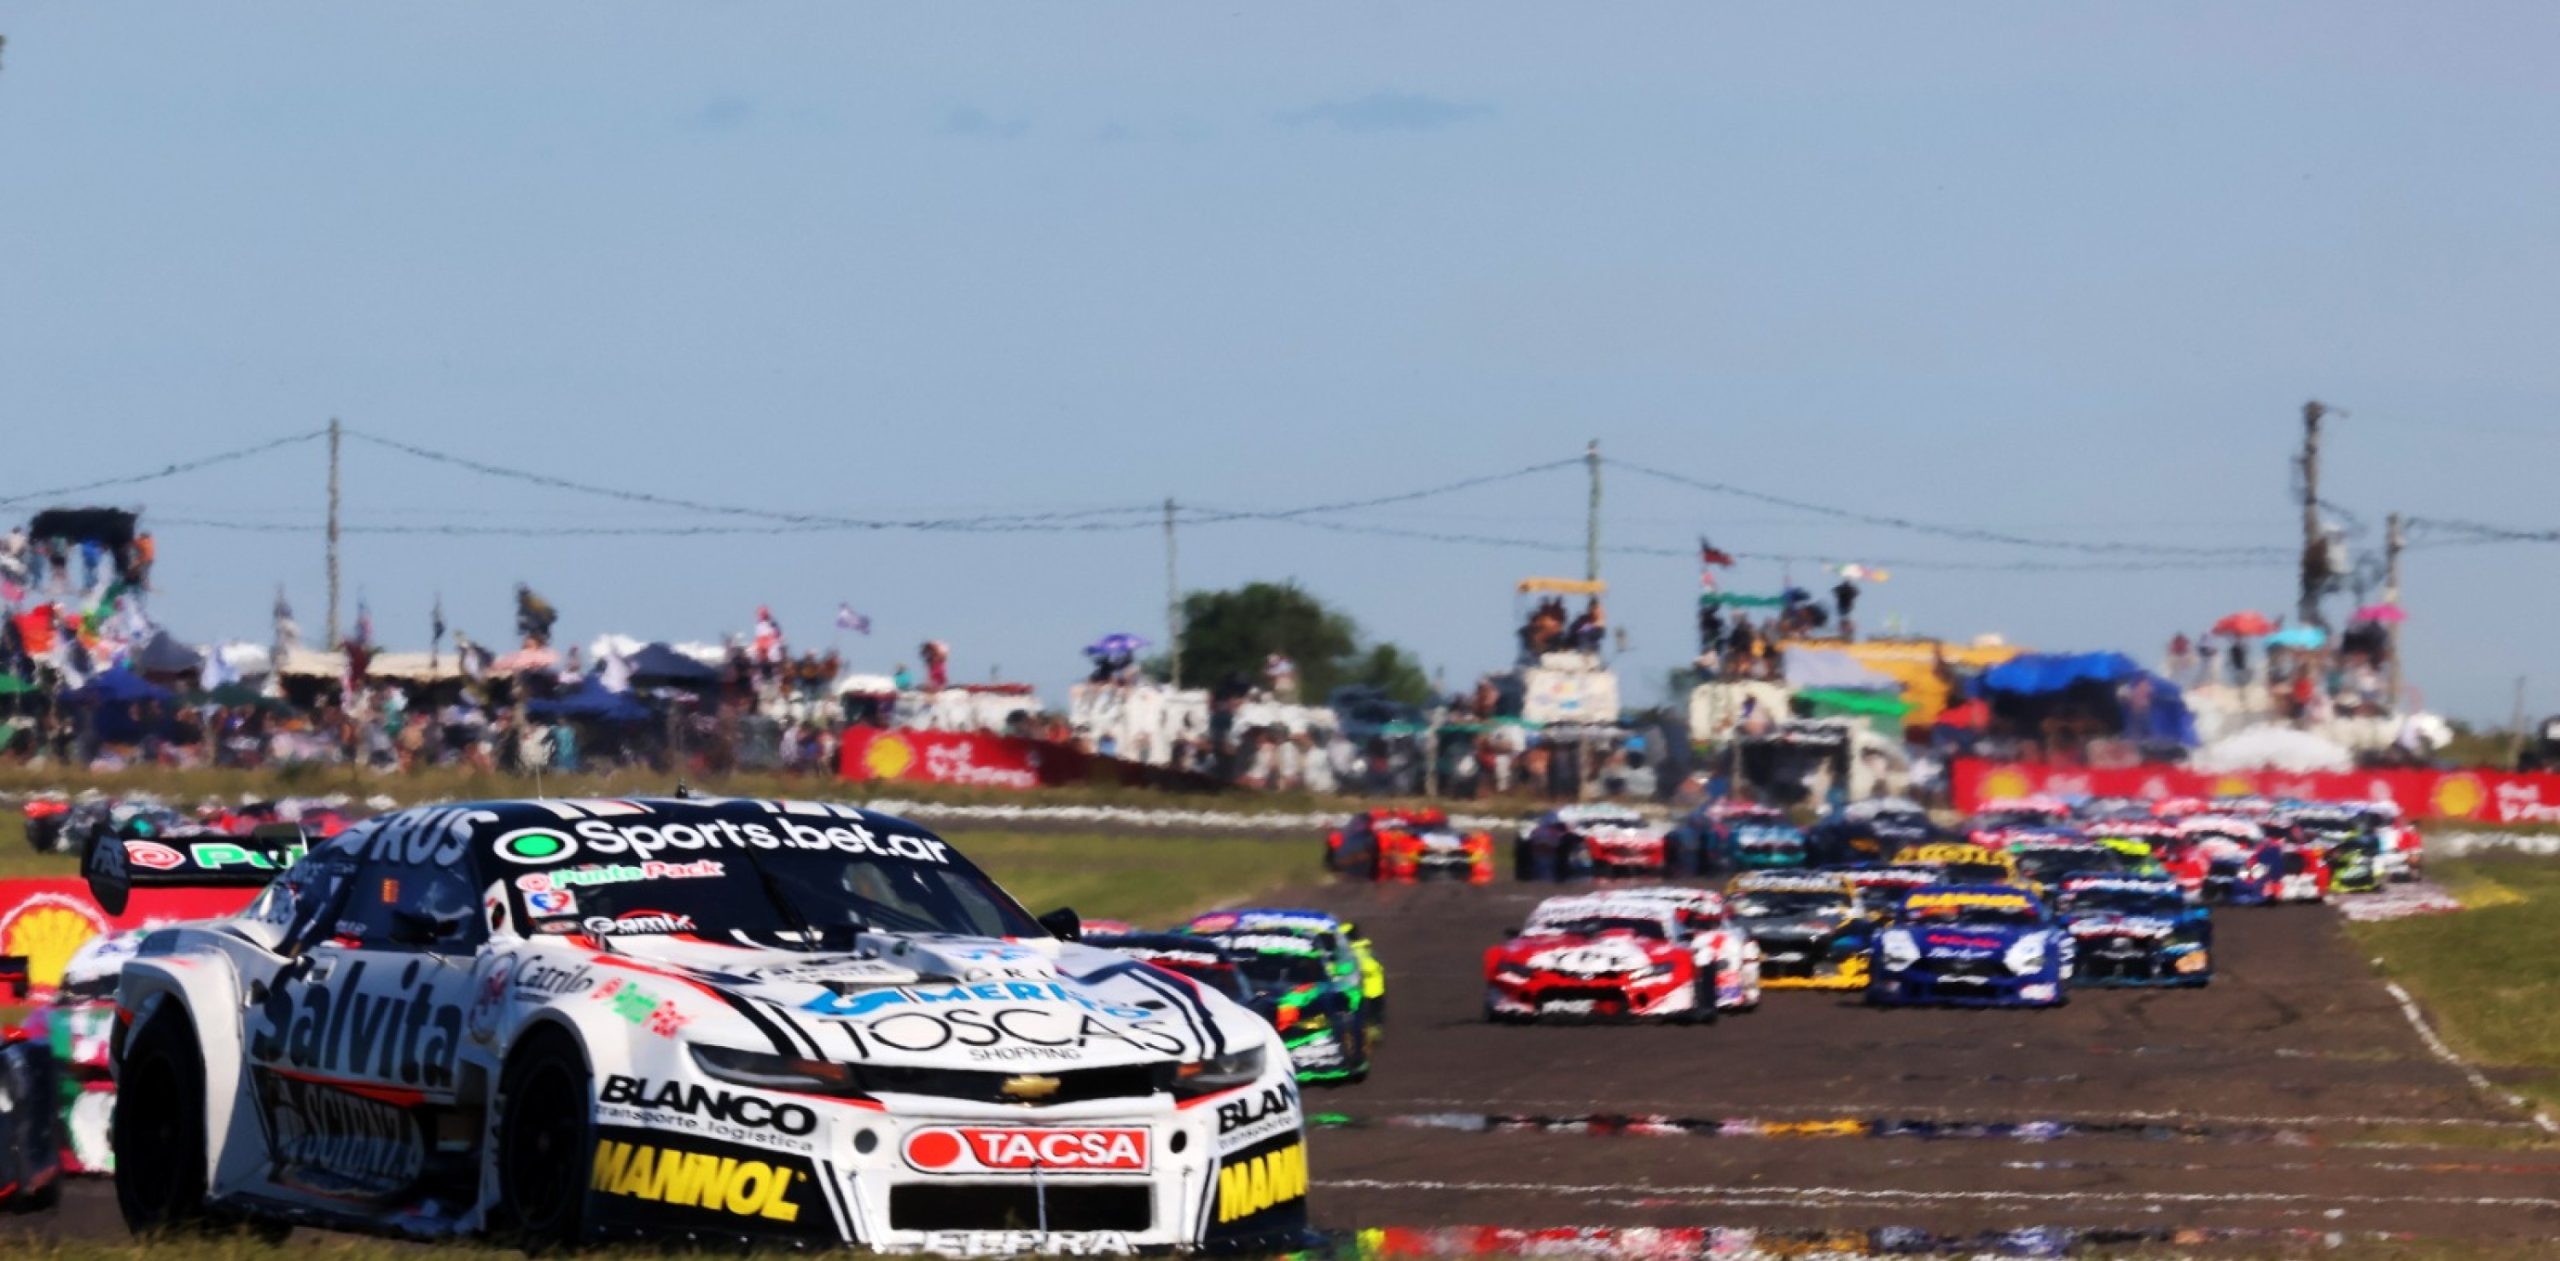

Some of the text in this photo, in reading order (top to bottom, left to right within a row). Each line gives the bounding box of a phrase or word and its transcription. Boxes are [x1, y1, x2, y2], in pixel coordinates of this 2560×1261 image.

[575, 816, 950, 865] Sports.bet.ar
[251, 957, 463, 1088] Salvita
[817, 1008, 1186, 1059] TOSCAS
[968, 1047, 1083, 1062] SHOPPING
[600, 1074, 818, 1136] BLANCO
[979, 1133, 1142, 1166] TACSA
[588, 1138, 800, 1223] MANNOL
